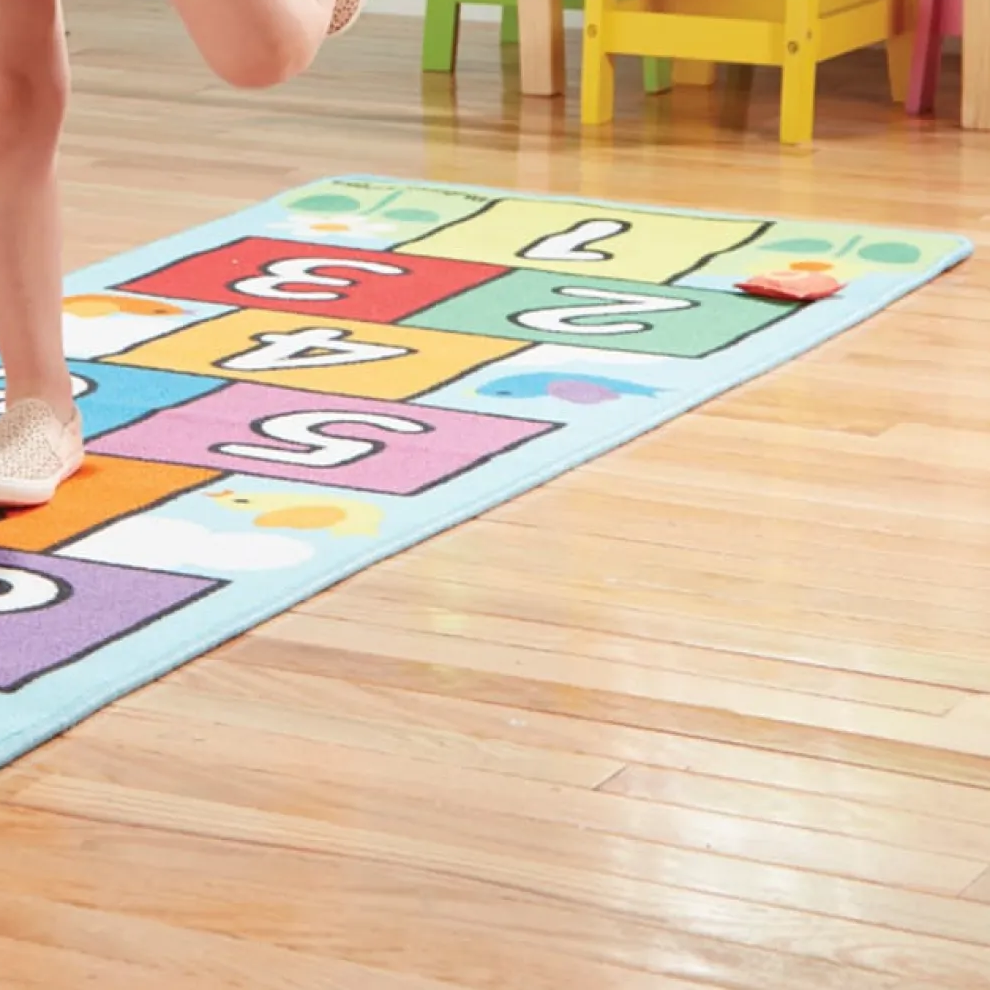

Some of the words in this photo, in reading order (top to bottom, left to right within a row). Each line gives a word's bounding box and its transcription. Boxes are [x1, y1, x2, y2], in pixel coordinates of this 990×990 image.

[515, 218, 632, 262] 1
[226, 256, 412, 302] 3
[507, 286, 701, 336] 2
[213, 326, 418, 372] 4
[208, 410, 435, 470] 5
